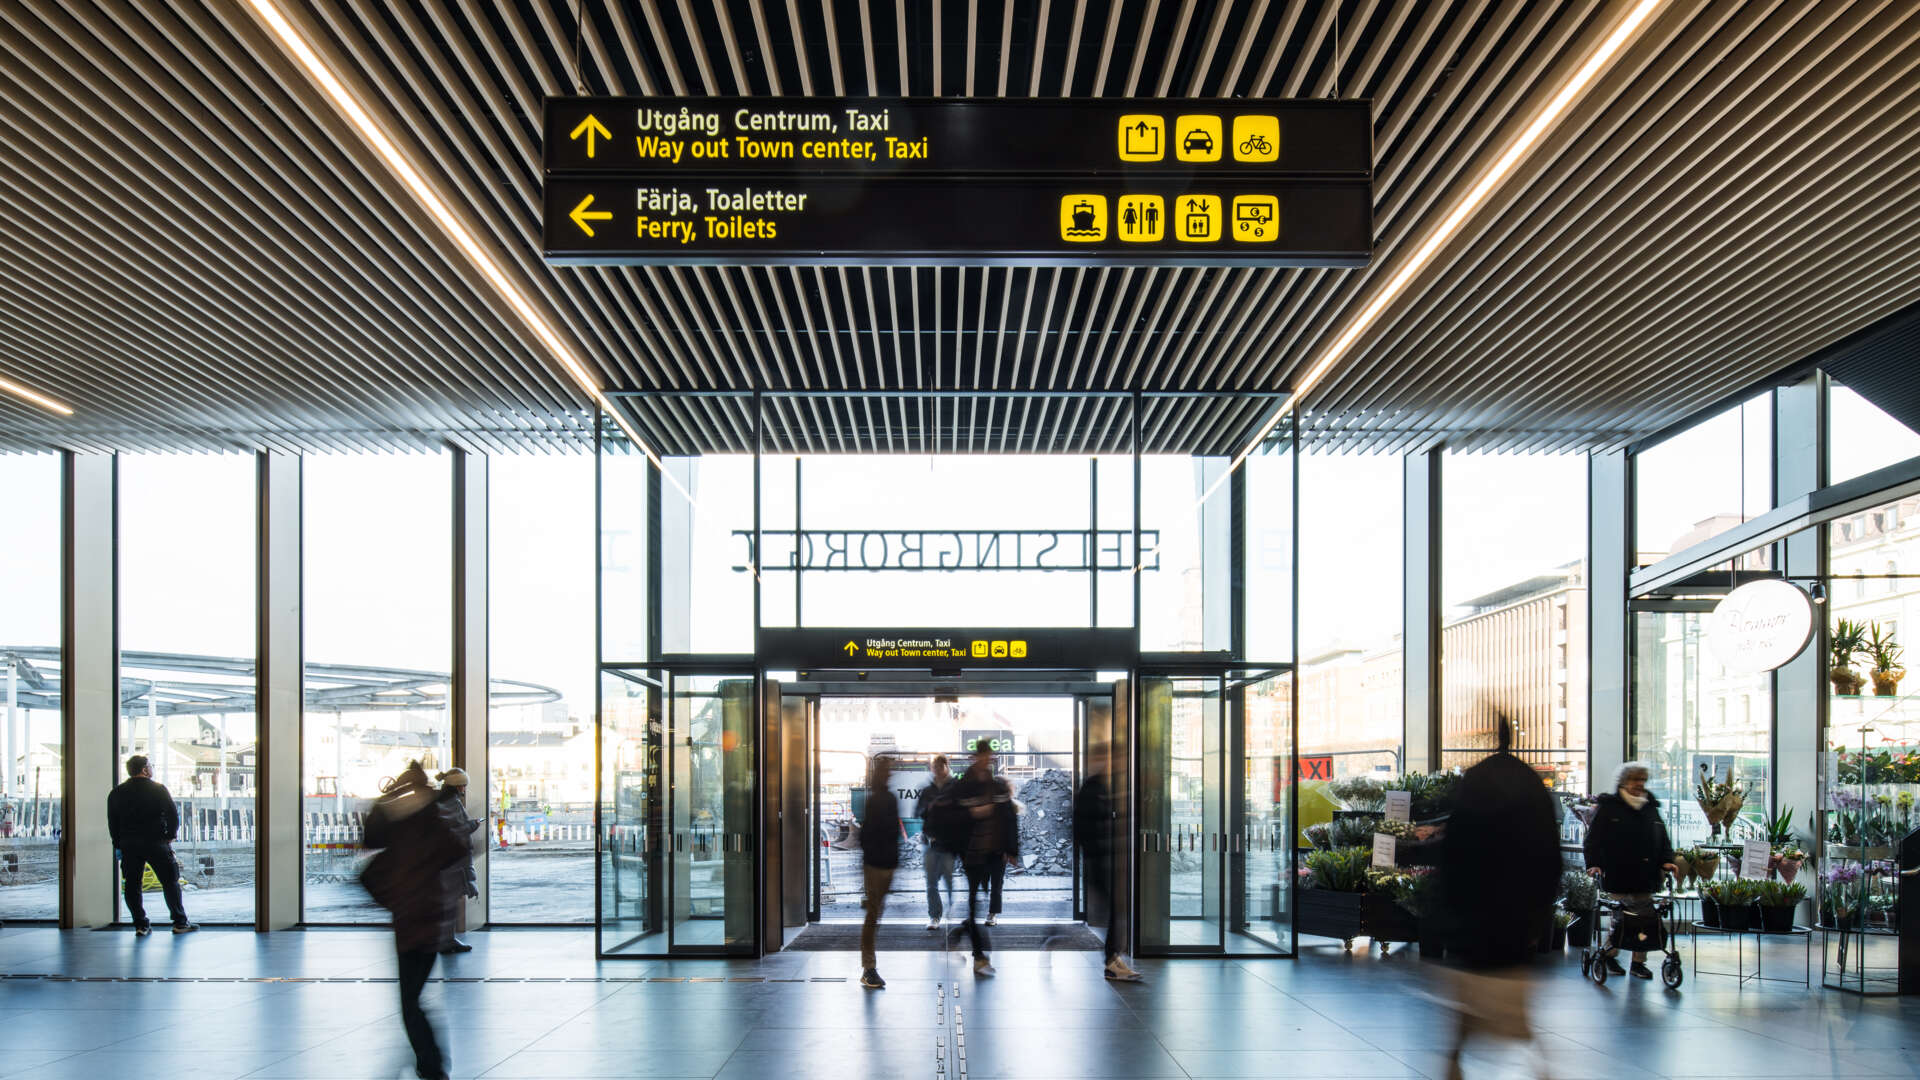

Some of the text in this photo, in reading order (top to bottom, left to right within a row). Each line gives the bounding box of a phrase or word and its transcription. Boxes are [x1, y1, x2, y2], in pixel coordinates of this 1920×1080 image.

[636, 107, 889, 136] Utgång Centrum, Taxi
[636, 137, 928, 163] Way out Town center, Taxi
[637, 188, 807, 215] Färja, Toaletter
[636, 217, 776, 245] Ferry, Toilets
[866, 639, 951, 650] Utgång Centrum, Taxi
[866, 648, 967, 659] Way out Town center, Taxi
